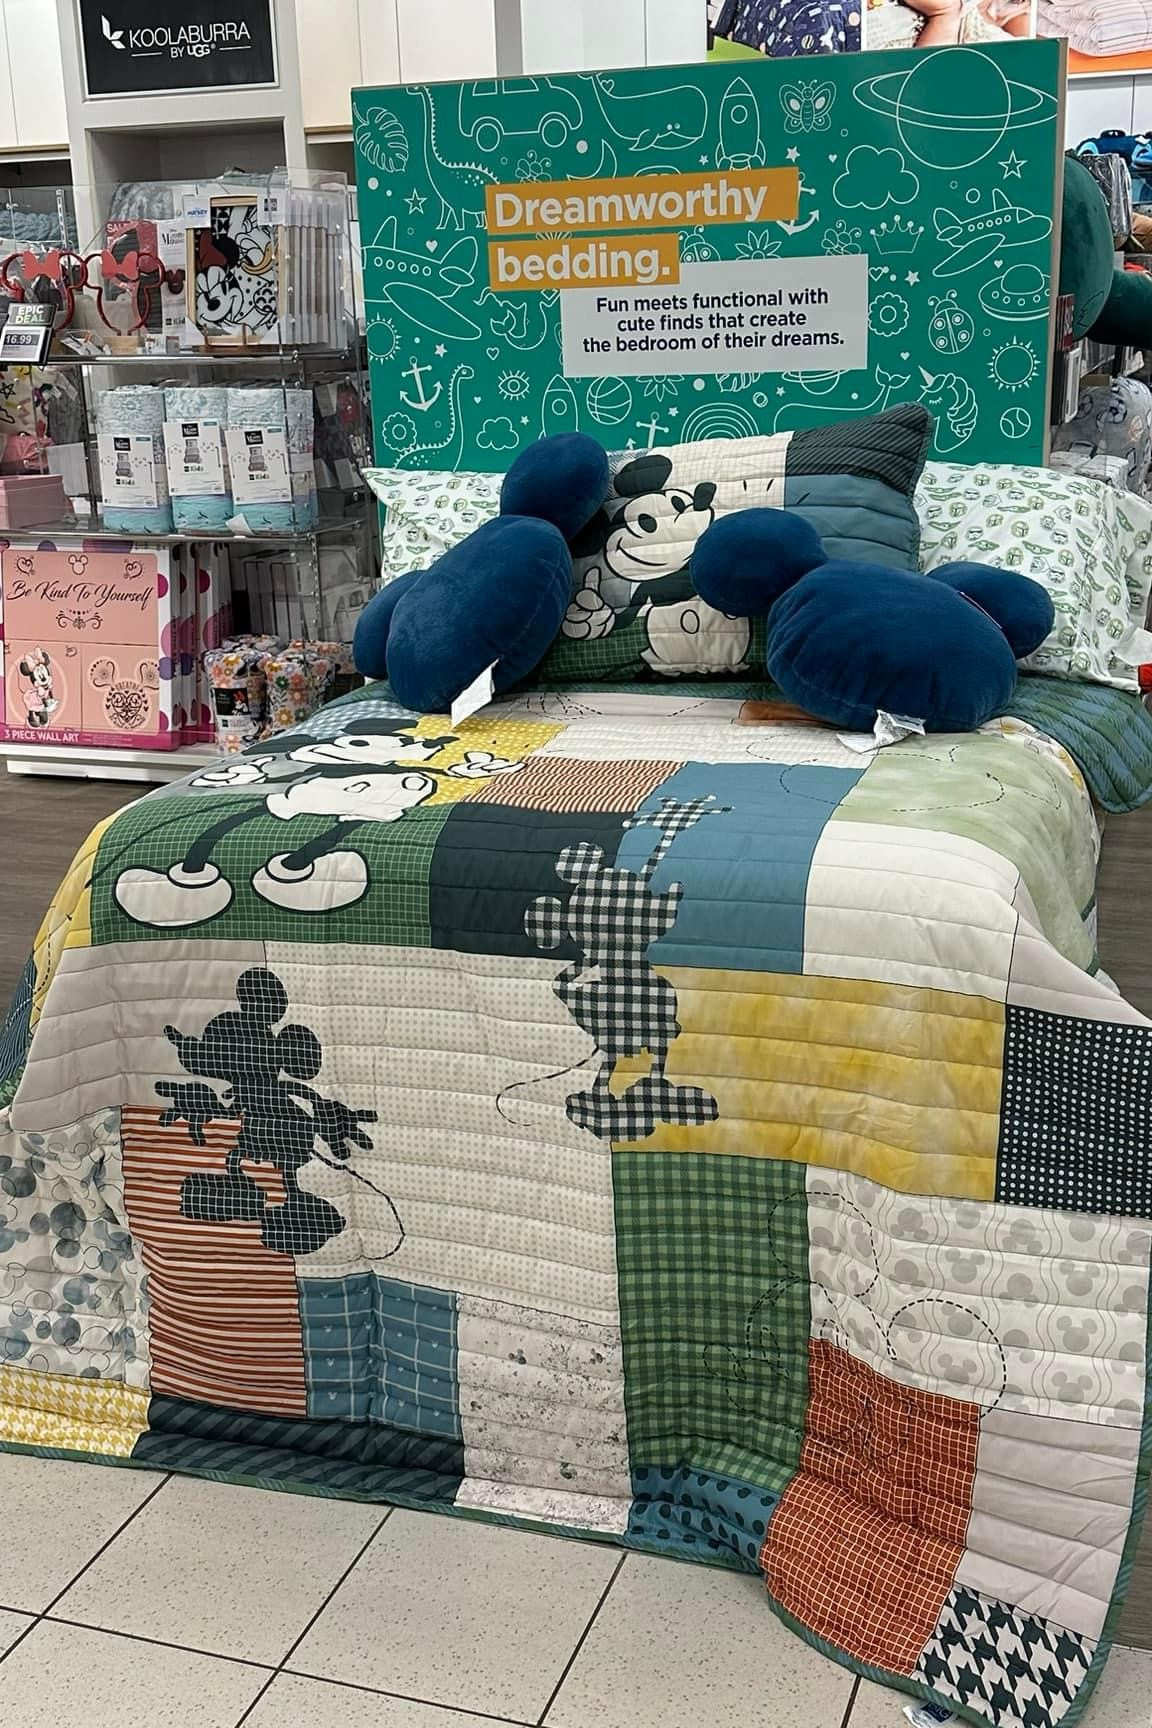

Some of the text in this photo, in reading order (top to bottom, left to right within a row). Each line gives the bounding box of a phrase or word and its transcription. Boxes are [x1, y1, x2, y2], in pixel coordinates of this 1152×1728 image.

[129, 22, 251, 48] KOOLABURRA
[170, 47, 185, 58] BY
[495, 179, 767, 227] Dreamworthy
[498, 243, 670, 283] bedding.
[18, 305, 44, 316] EPIC
[597, 288, 829, 312] Fun meets functional with
[15, 314, 45, 324] DEAL
[617, 311, 807, 331] cute finds that create
[6, 335, 32, 345] 16.99
[583, 330, 844, 352] the bedroom of their dreams.
[6, 580, 154, 611] Be Kind To Yourself
[4, 730, 10, 738] 3
[12, 730, 36, 740] PIECE
[36, 731, 61, 742] WALL
[62, 733, 79, 742] ART
